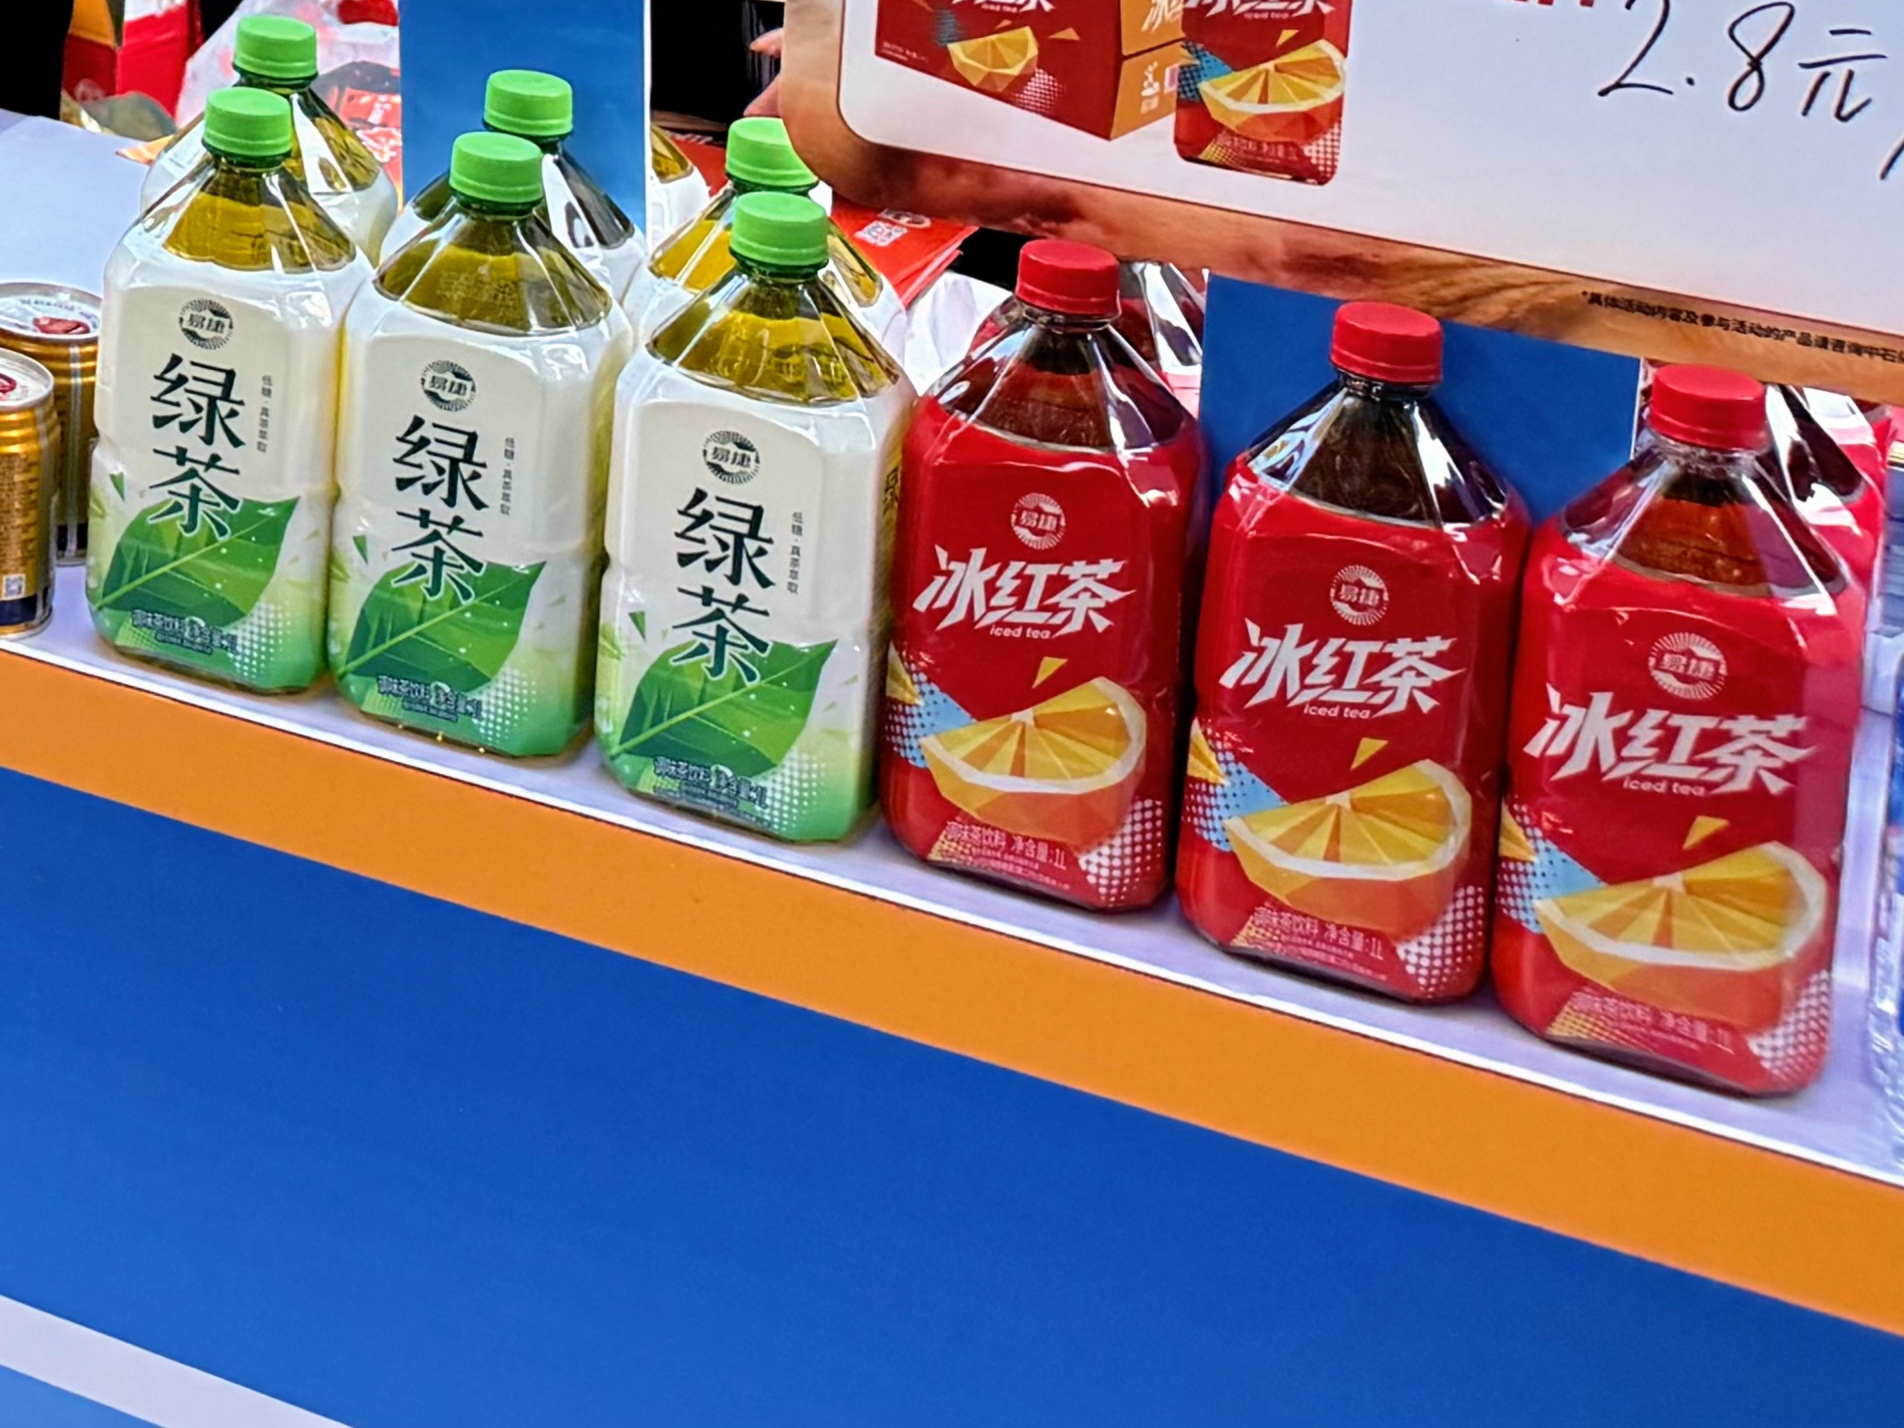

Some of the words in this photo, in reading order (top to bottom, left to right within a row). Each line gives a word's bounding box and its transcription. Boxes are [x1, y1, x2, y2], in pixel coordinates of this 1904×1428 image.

[186, 312, 226, 335] 易捷
[428, 374, 468, 398] 易捷
[149, 352, 246, 542] 绿茶
[711, 445, 753, 469] 易捷
[392, 414, 490, 605] 绿茶
[1019, 509, 1059, 533] 易捷
[669, 486, 777, 685] 绿茶
[913, 543, 1137, 638] 冰红茶
[1338, 581, 1382, 607] 易捷
[990, 624, 1023, 638] iced
[1025, 627, 1051, 640] tea
[1219, 617, 1467, 719] 冰红茶
[1658, 652, 1718, 681] 易捷
[1304, 702, 1341, 719] iced
[1343, 706, 1371, 720] tea
[1523, 682, 1819, 796] 冰红茶
[1623, 776, 1667, 794] iced
[1671, 780, 1706, 796] tea
